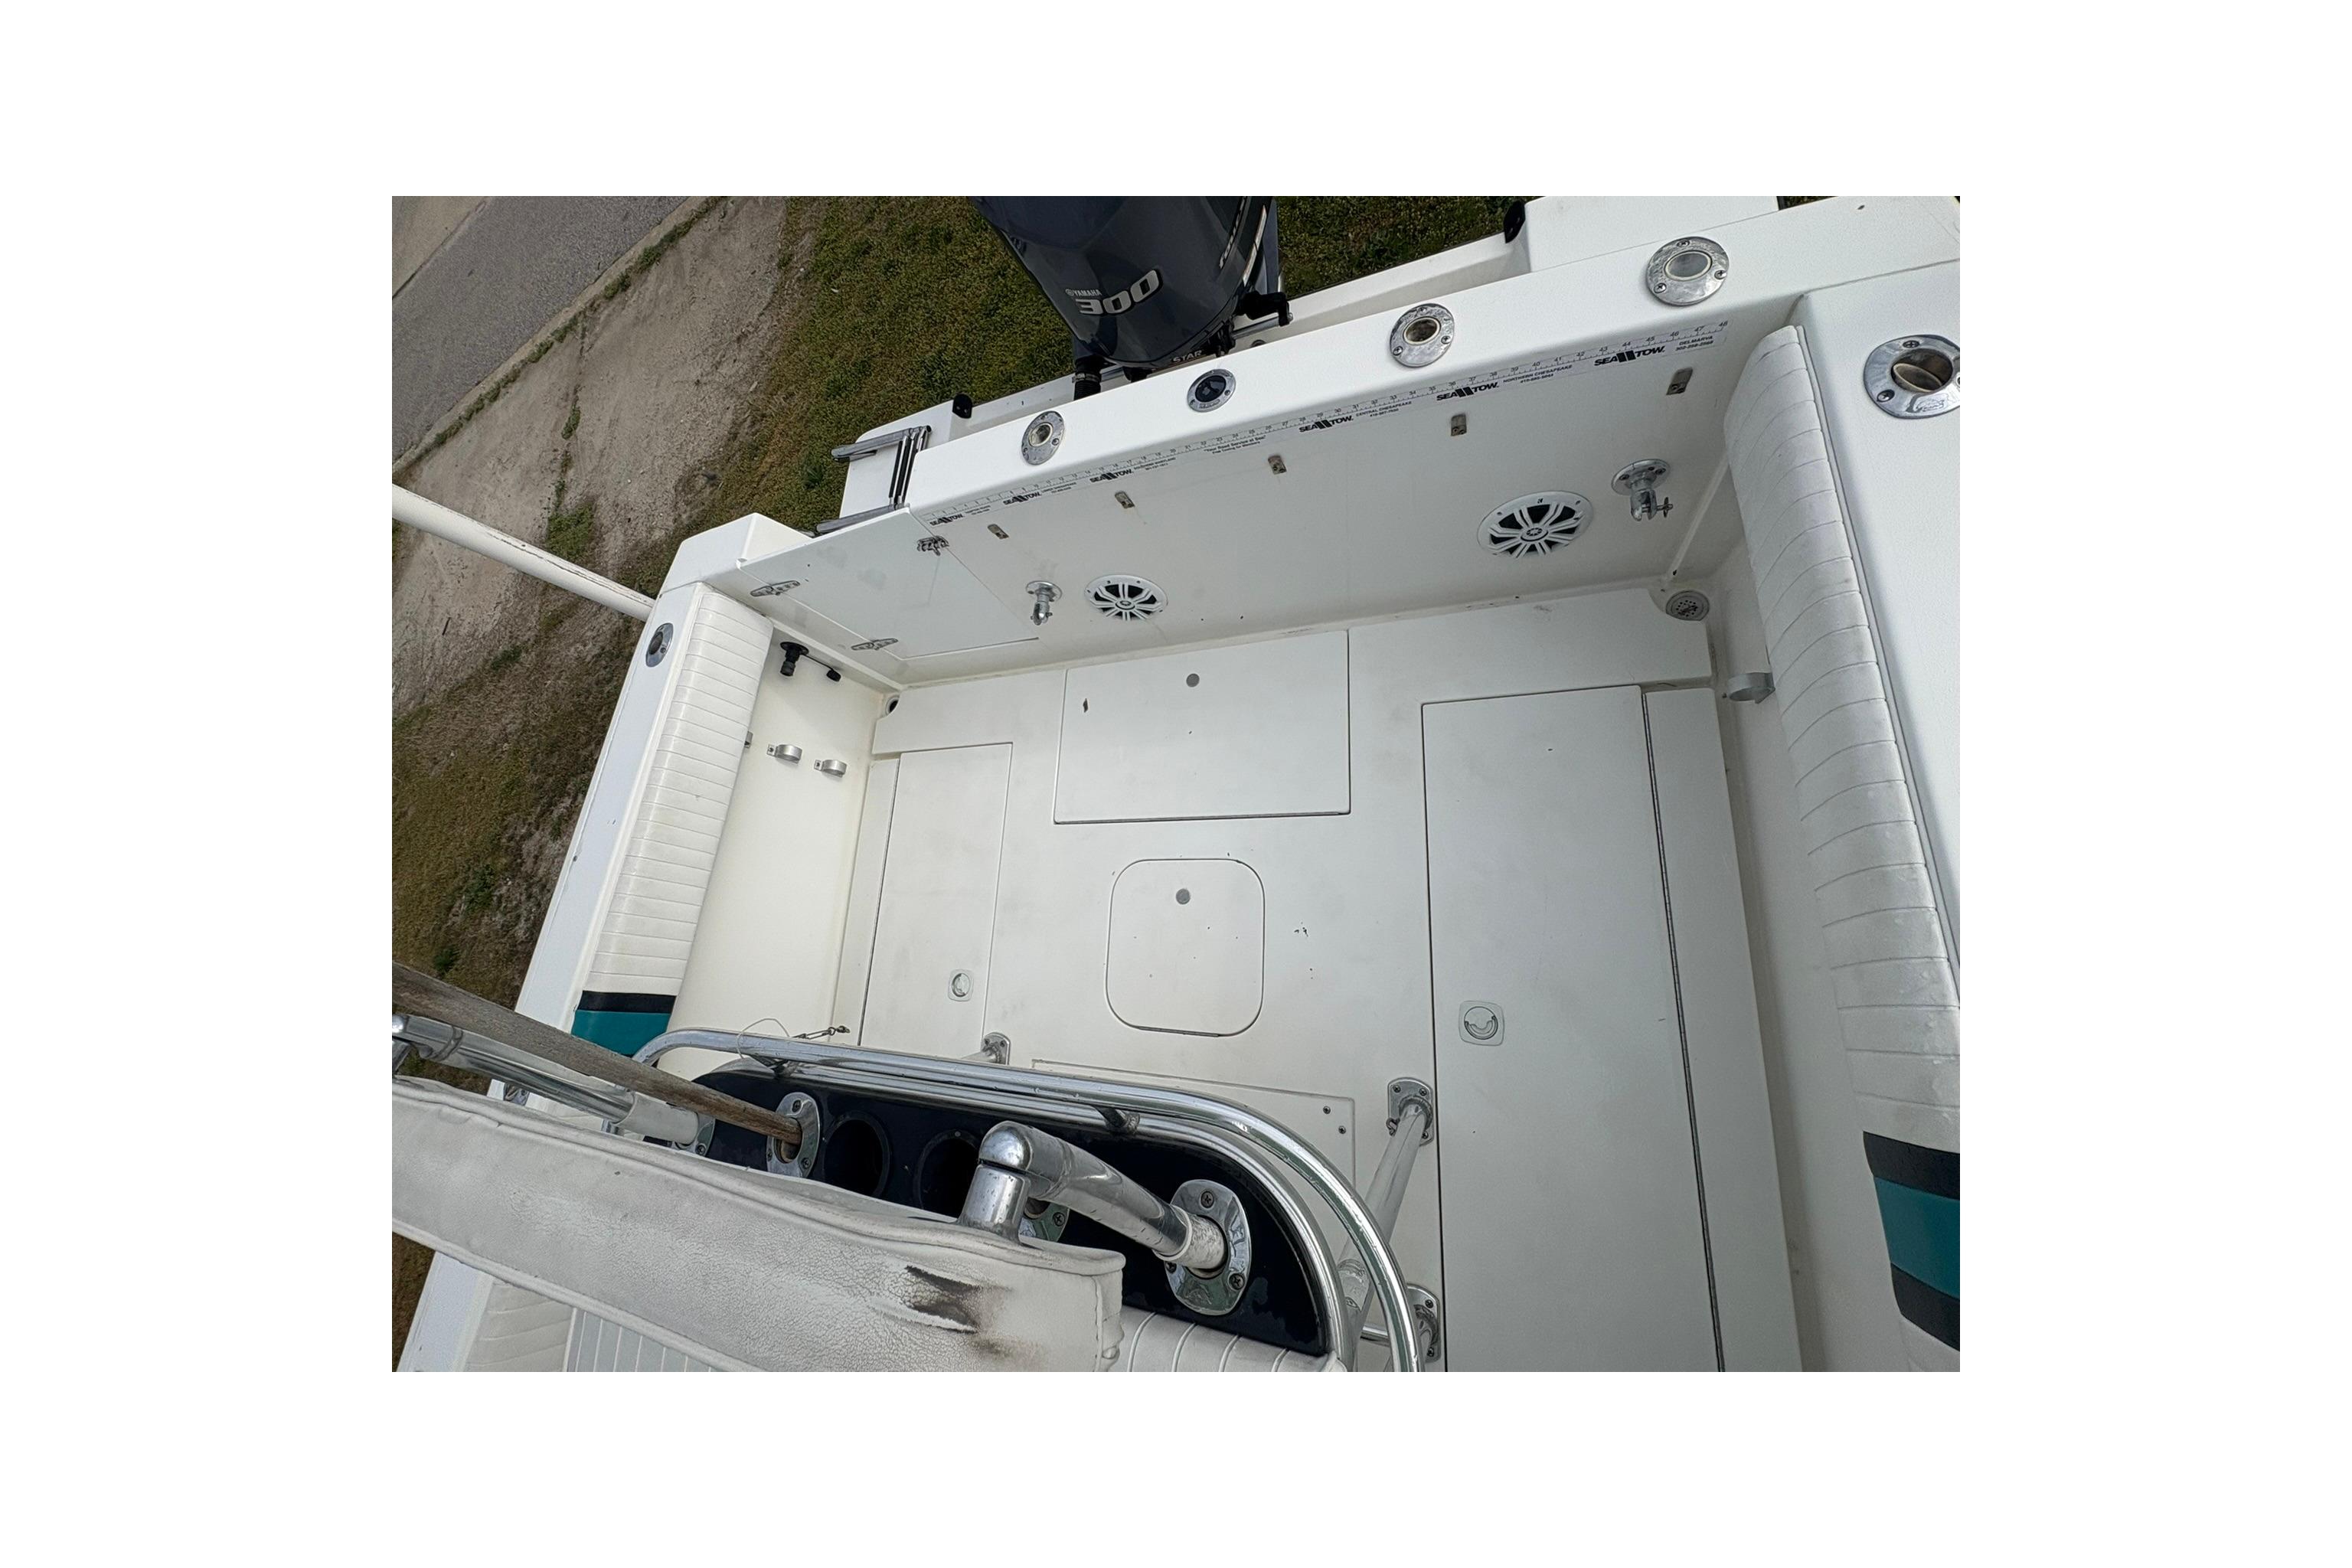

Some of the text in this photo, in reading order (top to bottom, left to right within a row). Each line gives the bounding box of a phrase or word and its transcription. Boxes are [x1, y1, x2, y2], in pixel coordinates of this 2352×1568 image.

[1075, 270, 1160, 315] 300
[1679, 335, 1713, 345] DELMARVA
[1172, 350, 1203, 363] STAR
[1594, 355, 1618, 366] SEA
[1503, 364, 1573, 383] NORTHERN CHESAPEAKE
[1436, 390, 1457, 400] SEA
[1379, 401, 1412, 411] CHESAPEAKE
[1299, 423, 1316, 433] SEA
[1090, 474, 1104, 482] SEA
